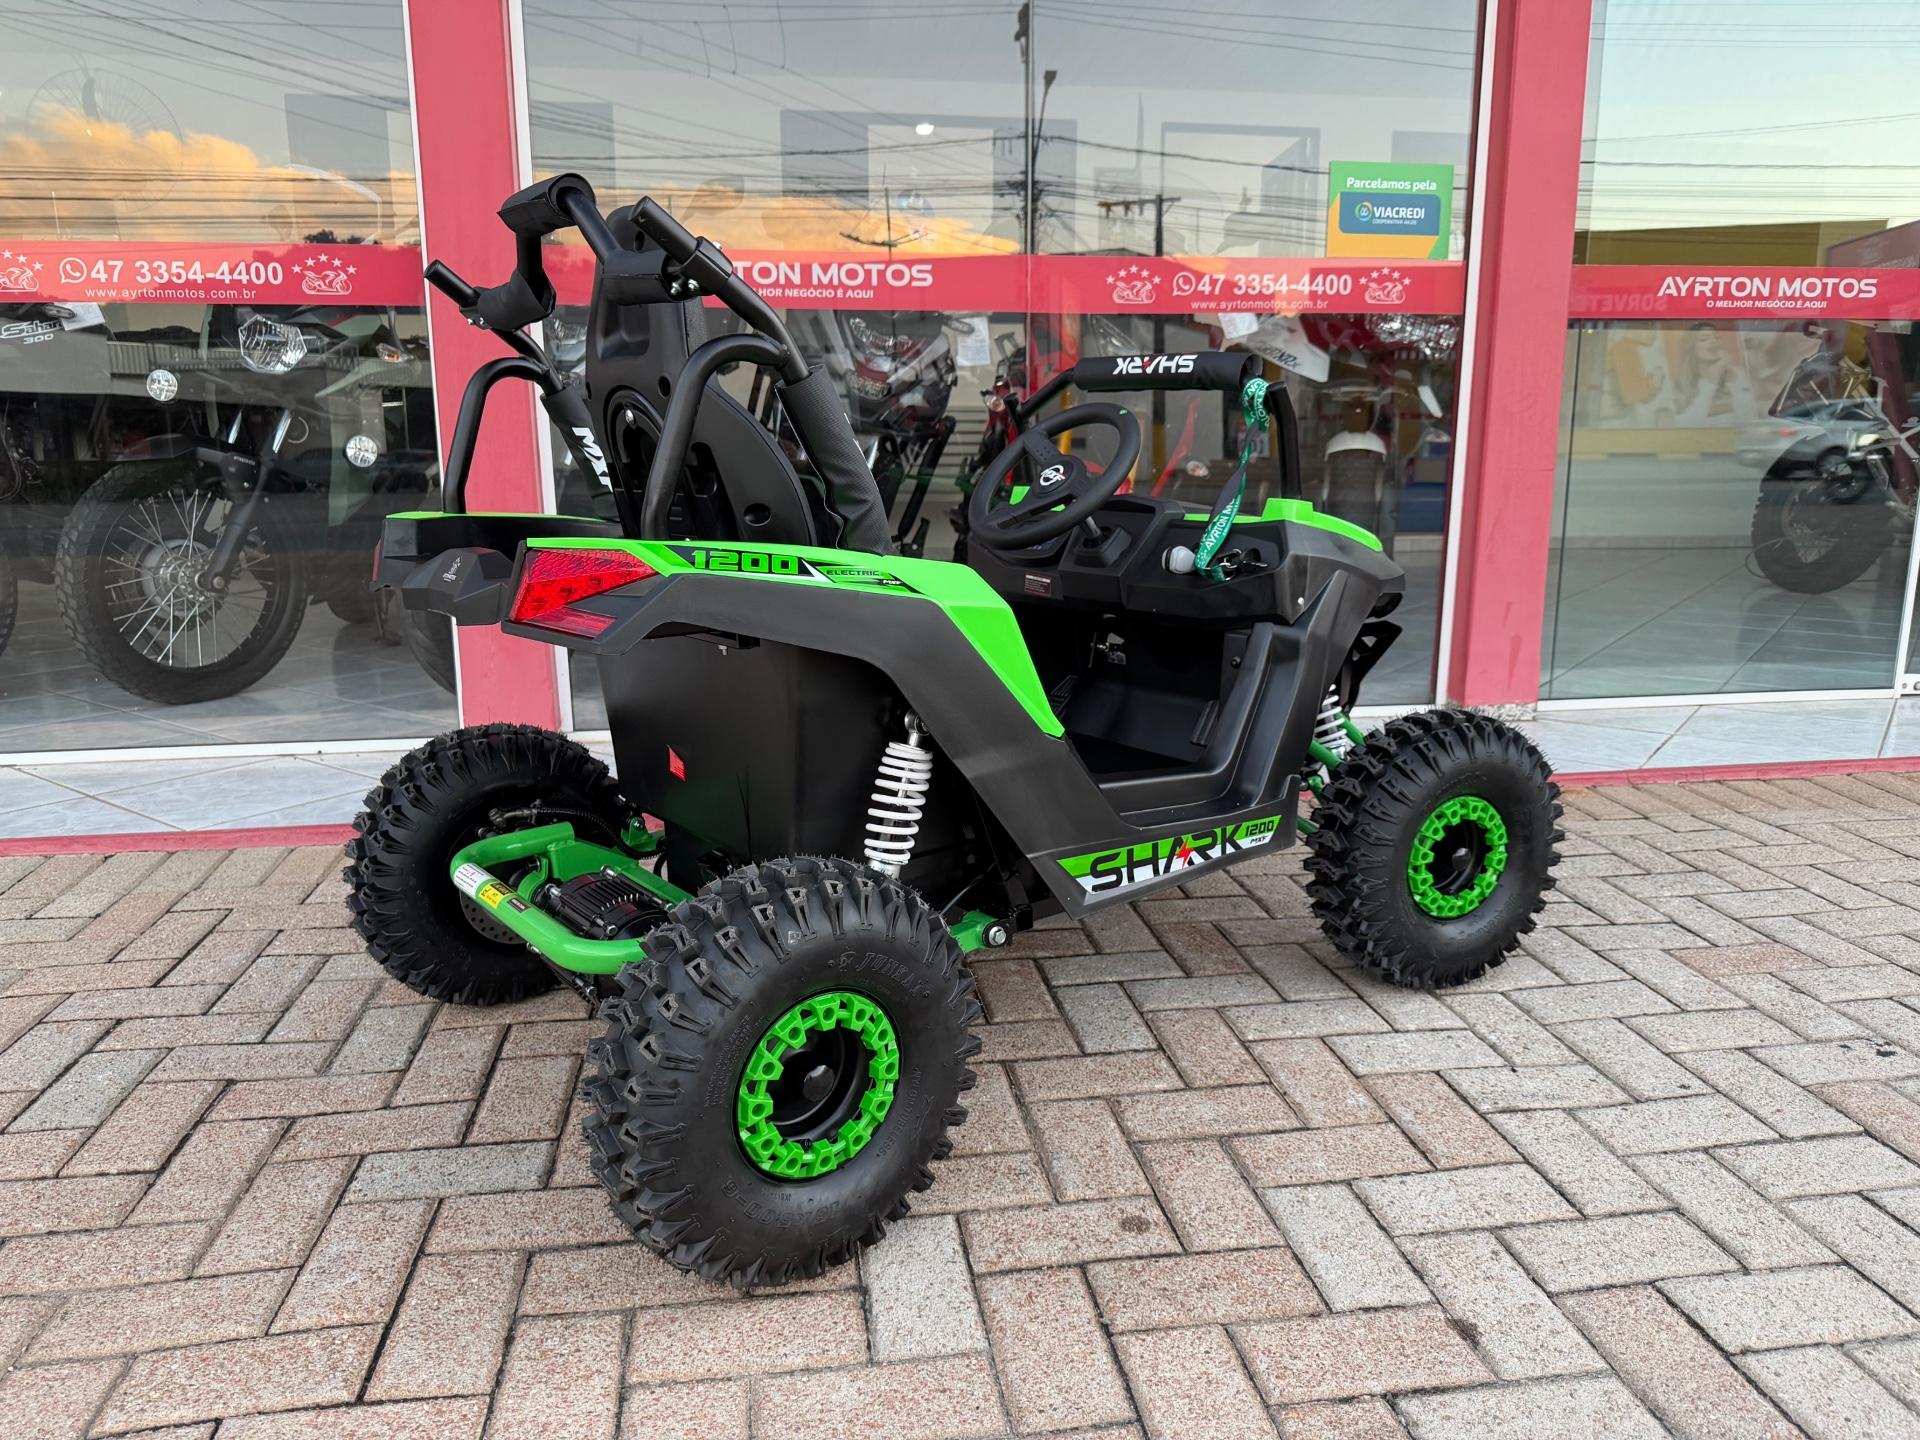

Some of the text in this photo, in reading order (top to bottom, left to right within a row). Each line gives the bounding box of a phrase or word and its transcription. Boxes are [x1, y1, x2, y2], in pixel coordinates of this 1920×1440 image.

[1346, 177, 1437, 192] Parcelamos pela
[1373, 206, 1425, 219] VIACREDI
[90, 260, 283, 285] 47 3354-4400
[732, 261, 934, 287] TON MOTOS
[85, 288, 256, 300] www.ayrtonmotos.com.br
[752, 287, 875, 299] HOR NEGÓCIO É AQUI
[1197, 274, 1352, 296] 47 3354-4400
[1656, 276, 1878, 299] AYRTON MOTOS
[1191, 299, 1328, 312] www.ayrtonmotos.com.br
[1715, 300, 1753, 308] MELHOR
[1754, 299, 1795, 309] NEGÓCIO
[1796, 299, 1803, 309] É
[1803, 300, 1828, 309] AQUI
[2, 320, 63, 338] Sahar
[23, 333, 54, 345] 300
[1112, 354, 1199, 376] SHARK
[1205, 515, 1230, 551] AYRTON
[691, 550, 799, 575] 1200
[1245, 820, 1275, 837] 1200
[1089, 824, 1245, 893] SHARK
